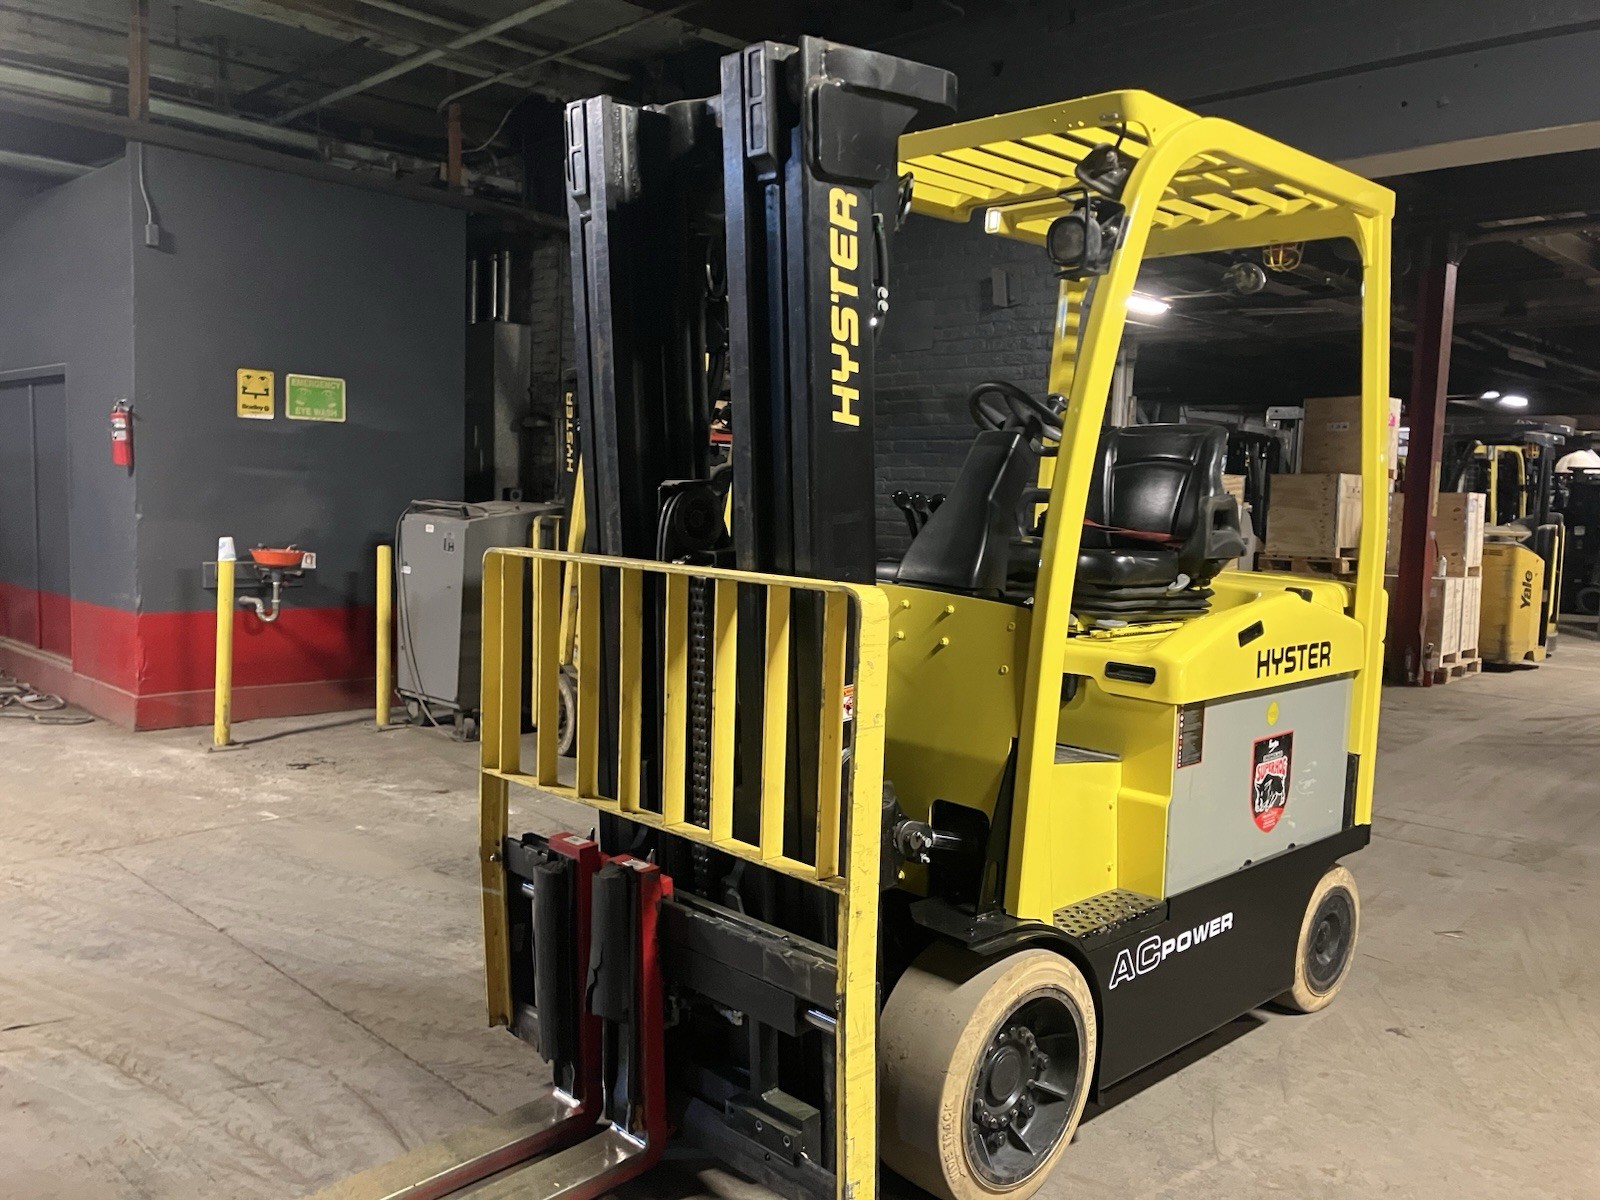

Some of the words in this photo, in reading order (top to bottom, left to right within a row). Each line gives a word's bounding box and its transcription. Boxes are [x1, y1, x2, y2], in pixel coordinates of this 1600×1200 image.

[829, 187, 860, 427] HYSTER
[291, 378, 341, 390] EMERGENCY
[241, 403, 264, 411] Bradley
[295, 407, 312, 416] EYE
[313, 408, 338, 418] WASH
[566, 392, 574, 472] HYSTER
[1520, 570, 1533, 609] Yale
[1257, 641, 1331, 679] HYSTER
[942, 1102, 953, 1151] TRACK
